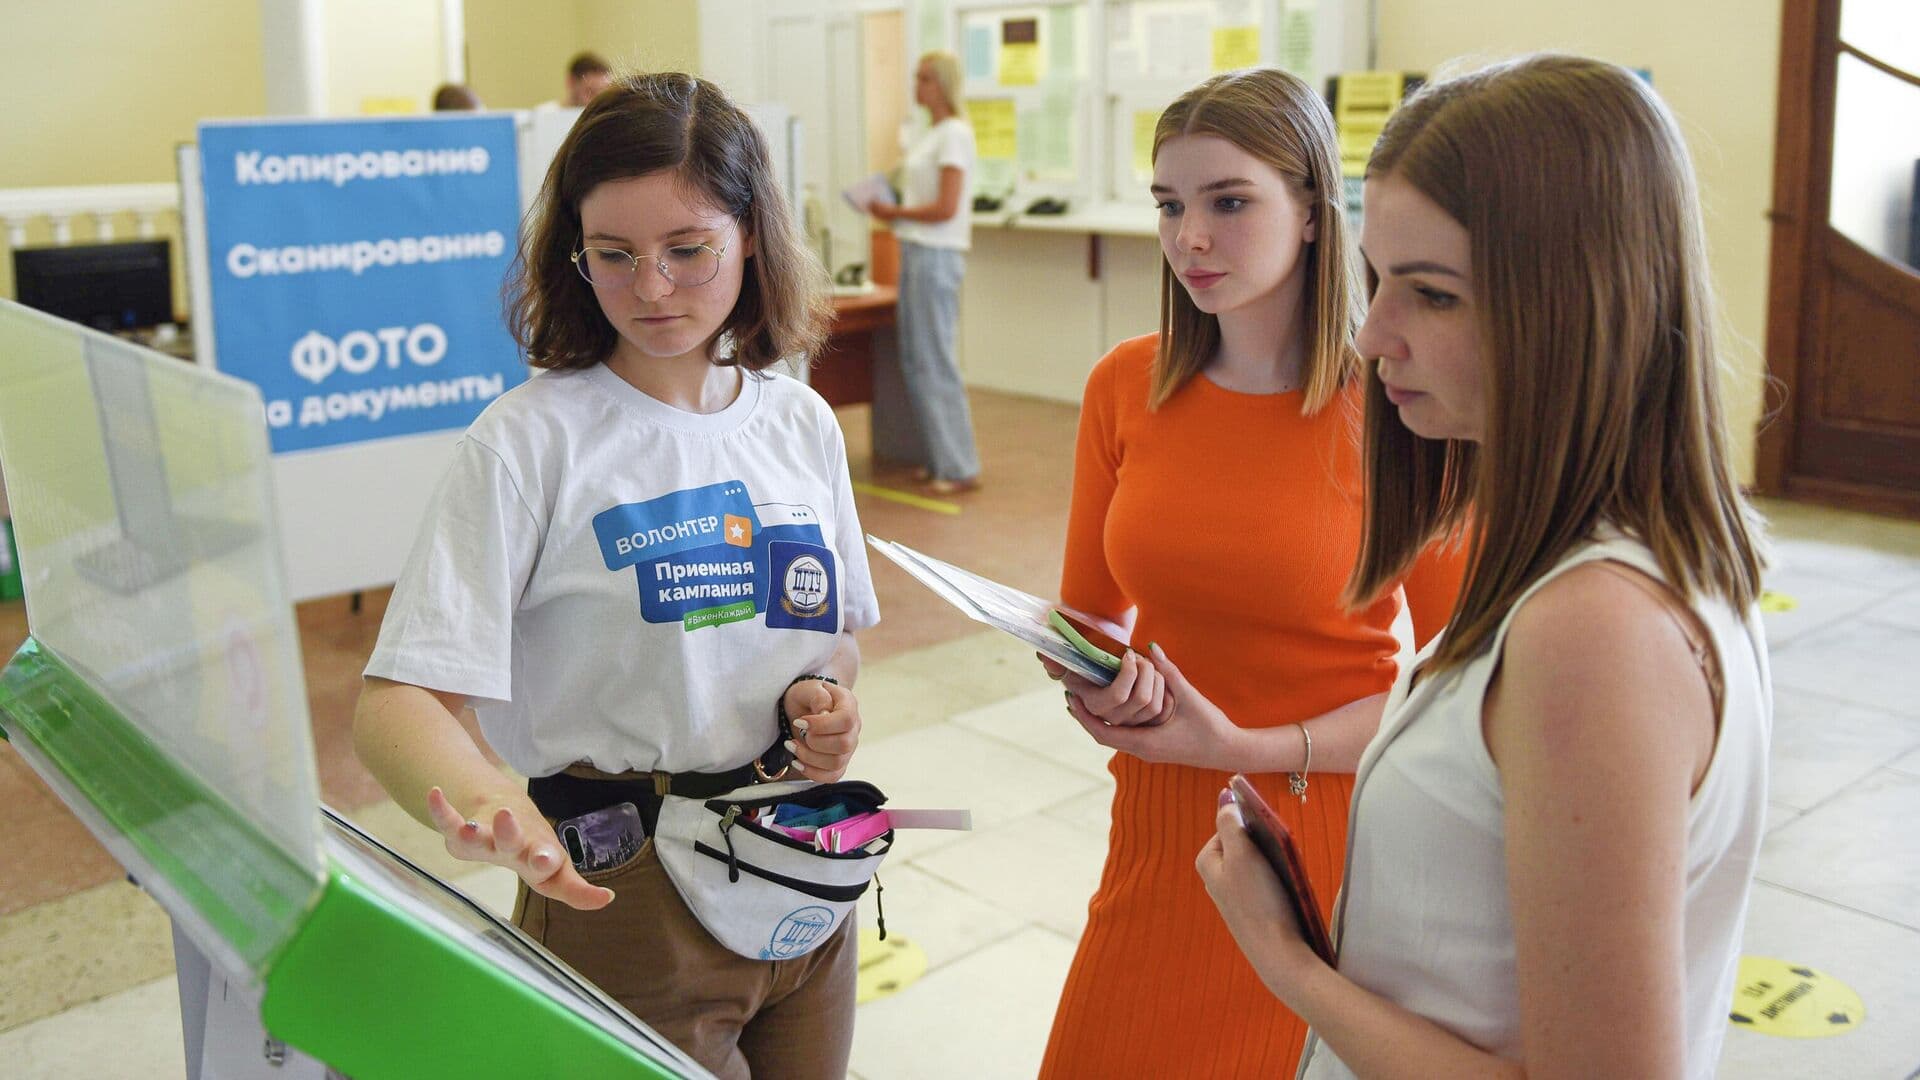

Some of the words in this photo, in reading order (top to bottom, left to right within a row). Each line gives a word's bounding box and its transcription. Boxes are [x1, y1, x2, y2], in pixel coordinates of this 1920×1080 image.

[235, 146, 490, 186] Копирование
[227, 231, 505, 278] Сканирование
[291, 323, 448, 384] ФОТО
[265, 400, 293, 428] а
[299, 374, 504, 426] документы
[615, 515, 719, 556] ВОЛОНТЕР
[655, 560, 755, 584] Приемная
[658, 581, 754, 603] кампания
